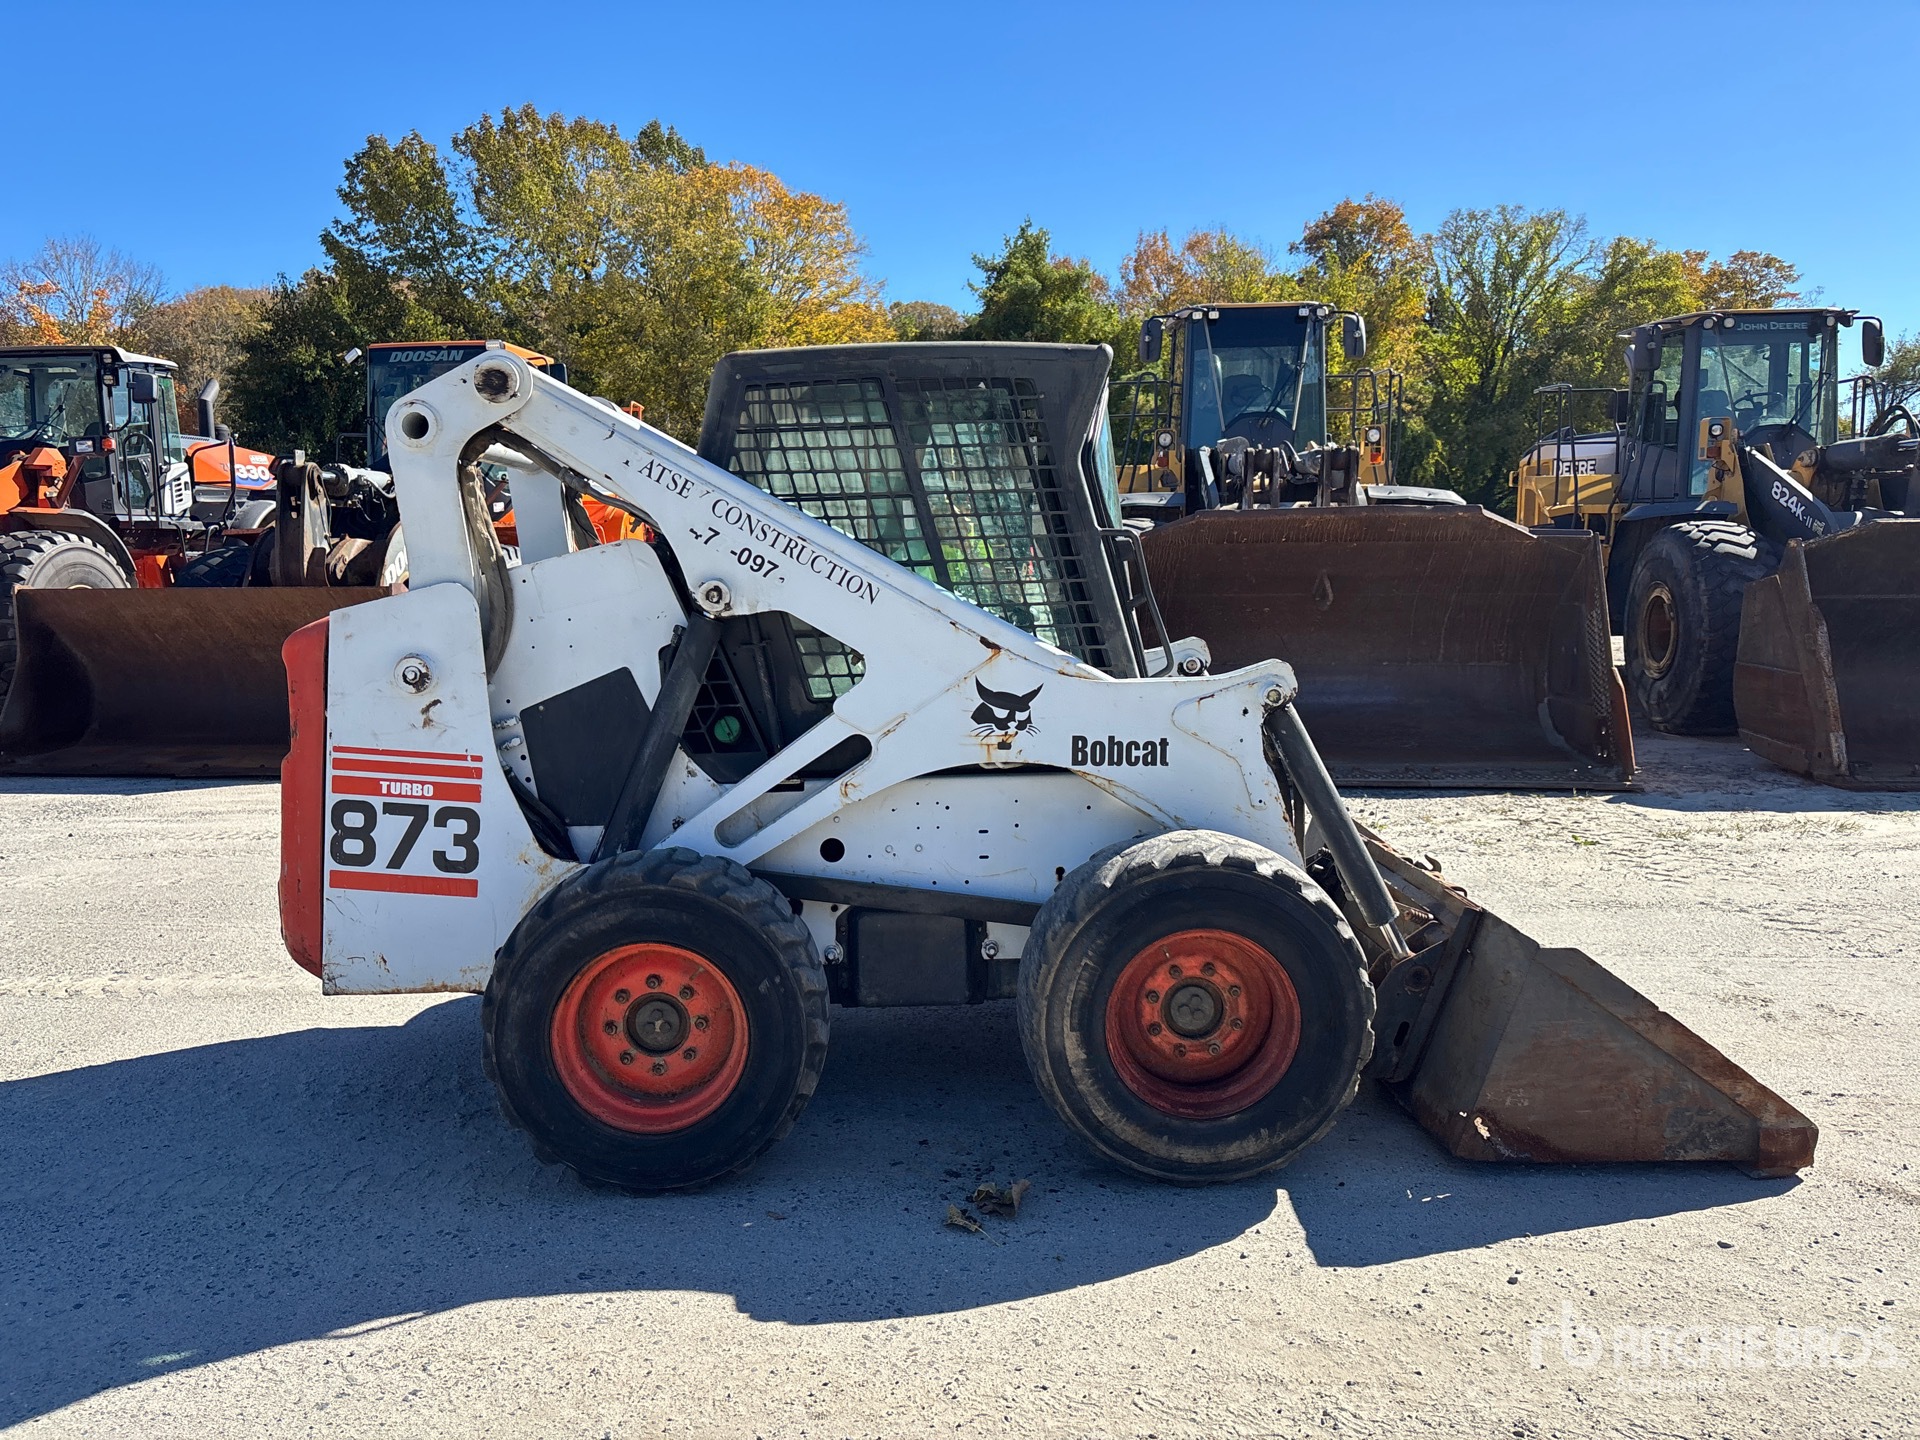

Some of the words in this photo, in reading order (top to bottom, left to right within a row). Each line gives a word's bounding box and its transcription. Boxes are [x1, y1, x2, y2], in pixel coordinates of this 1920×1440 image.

[1737, 322, 1768, 331] JOHN
[1769, 321, 1809, 331] DEERE
[388, 350, 465, 363] DOOSAN
[711, 498, 880, 605] CONSTRUCTION
[1071, 735, 1170, 767] Bobcat
[379, 780, 434, 797] TURBO
[330, 799, 481, 875] 873
